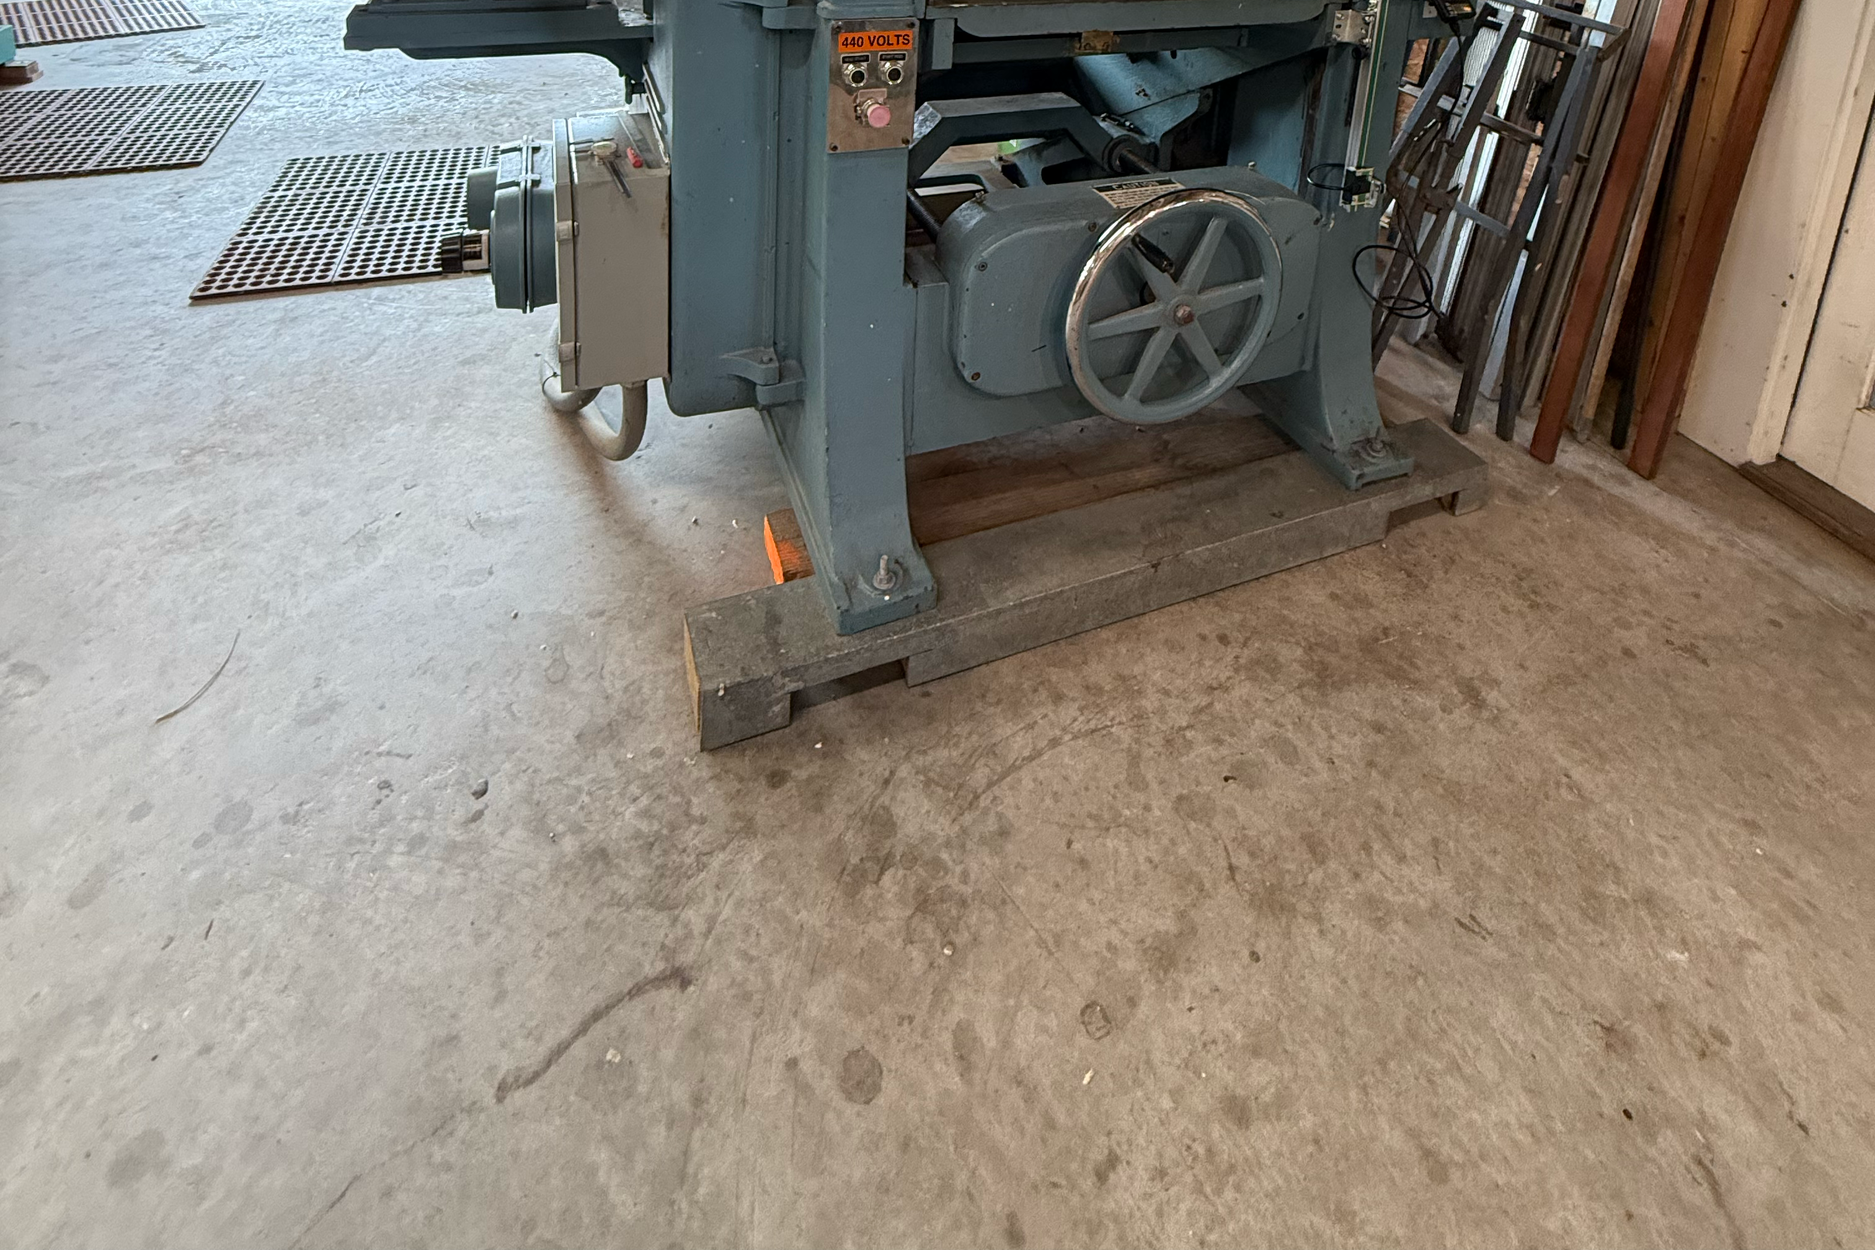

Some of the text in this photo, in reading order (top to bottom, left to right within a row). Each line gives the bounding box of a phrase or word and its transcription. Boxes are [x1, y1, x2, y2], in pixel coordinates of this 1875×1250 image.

[842, 34, 911, 48] 440 VOLTS
[1112, 181, 1160, 190] CAUTION
